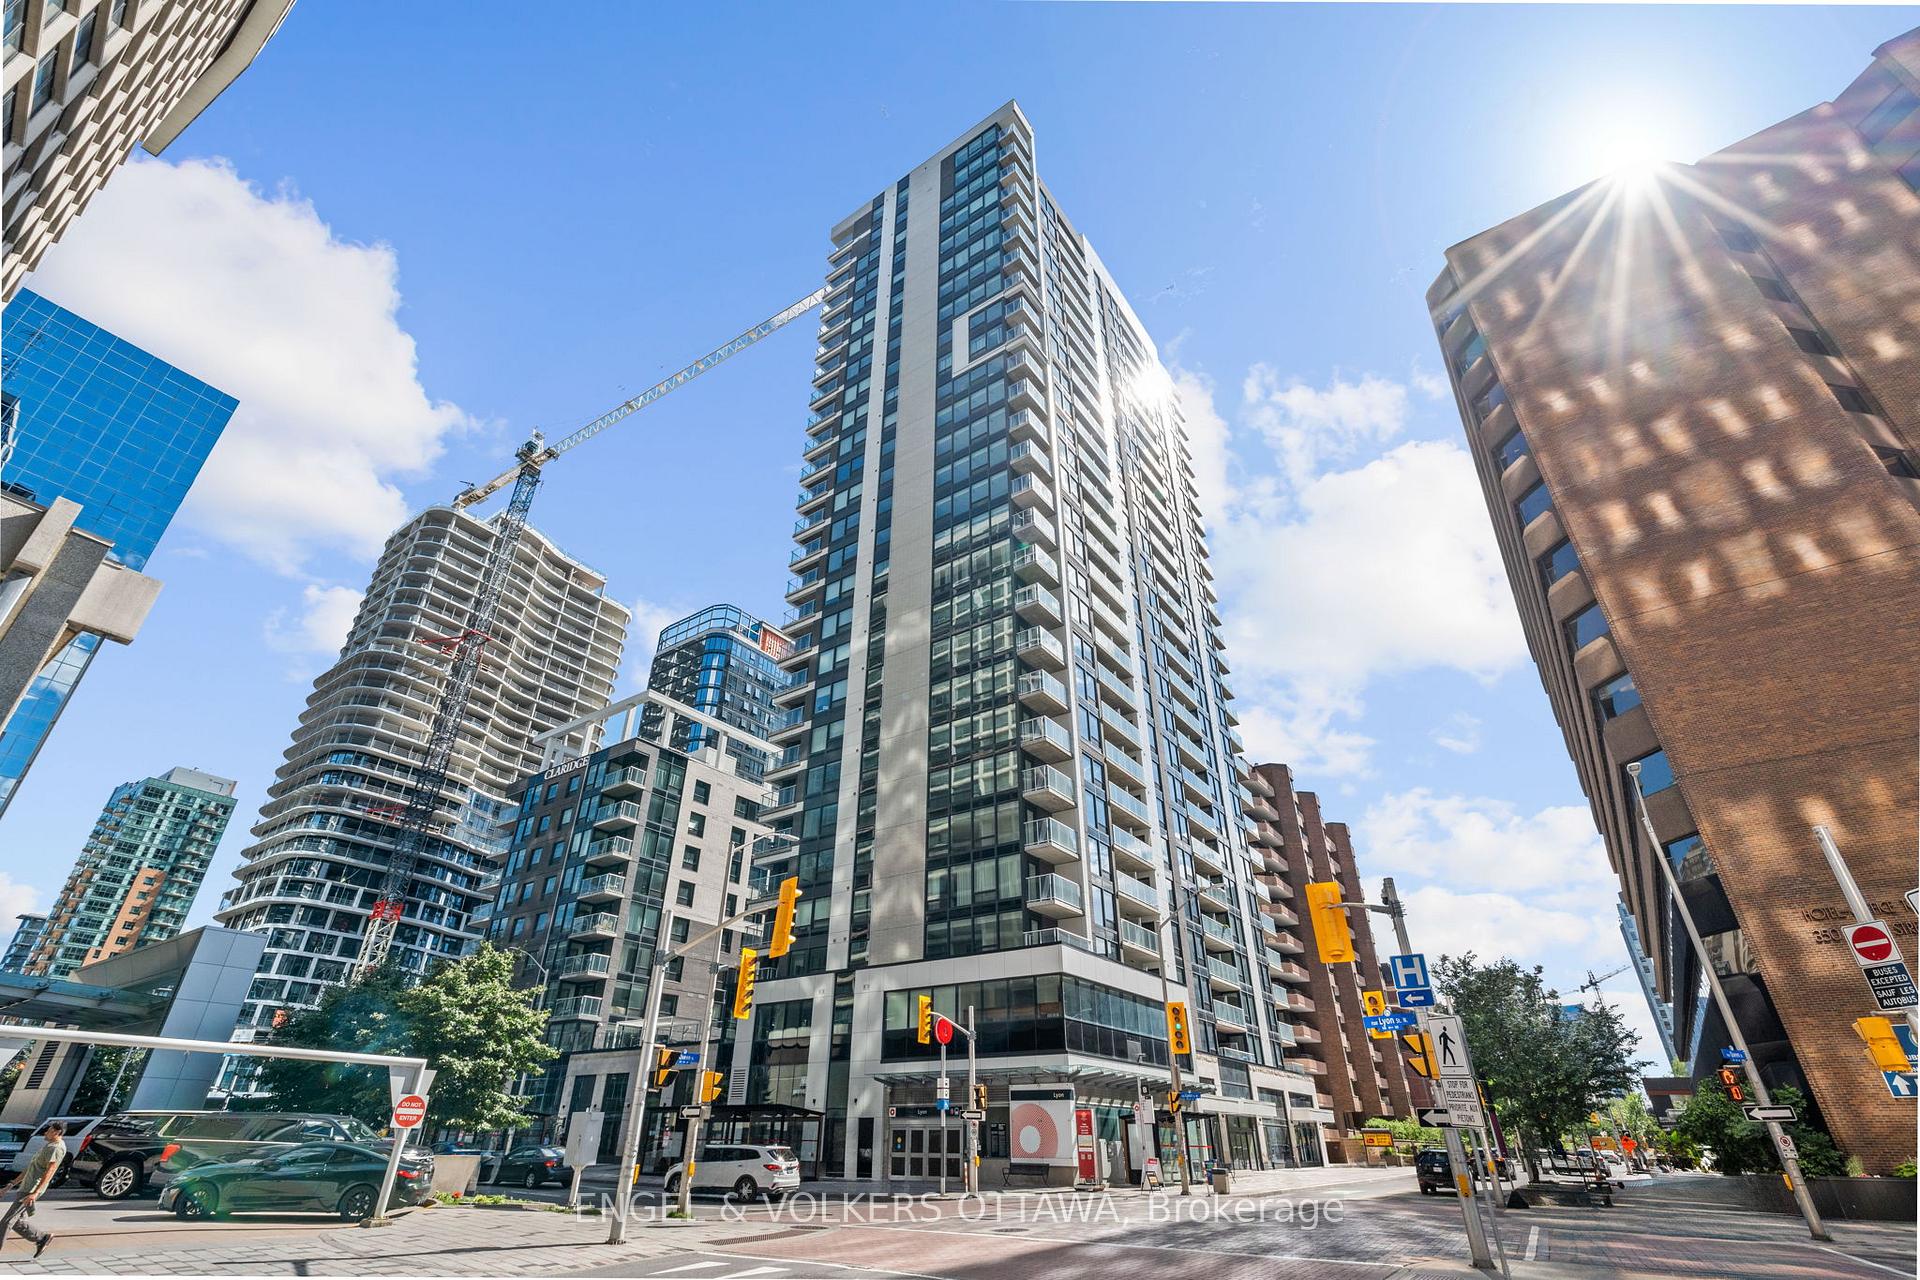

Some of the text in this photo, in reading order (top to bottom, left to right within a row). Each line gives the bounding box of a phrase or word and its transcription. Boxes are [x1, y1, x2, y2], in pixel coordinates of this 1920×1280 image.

[544, 756, 590, 780] CLARIDGE
[1812, 928, 1841, 944] 350
[1395, 957, 1425, 987] H
[1872, 965, 1899, 977] BUSES
[1871, 974, 1909, 987] EXCEPTED
[1876, 986, 1916, 999] SAUF LES
[1883, 995, 1918, 1007] AUTOBUS
[1378, 1017, 1395, 1027] Lyon
[1447, 1080, 1469, 1089] STOP FOR
[1446, 1091, 1475, 1100] PEDESTRIANS
[1469, 1104, 1479, 1112] AUX
